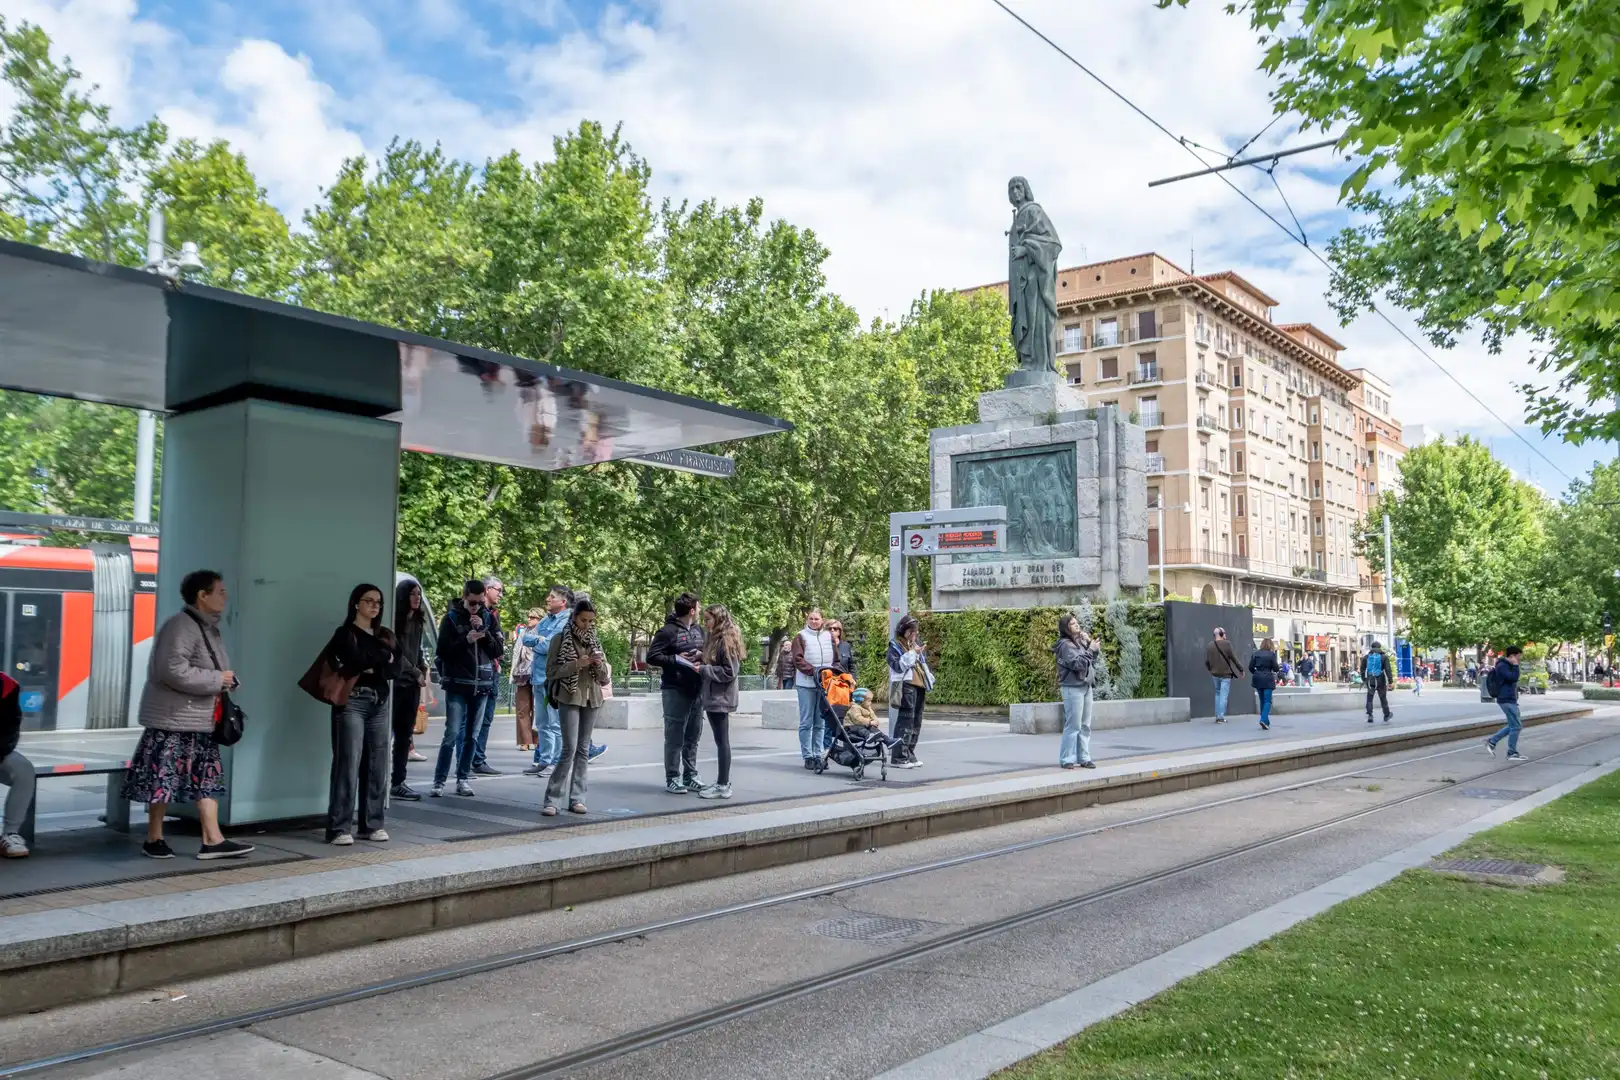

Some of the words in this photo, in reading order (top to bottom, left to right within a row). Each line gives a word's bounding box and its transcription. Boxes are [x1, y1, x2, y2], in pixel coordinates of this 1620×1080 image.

[679, 453, 732, 473] FRANCISCO
[51, 518, 86, 528] PLAZA
[91, 521, 104, 530] DE
[110, 522, 130, 531] SAN
[1000, 566, 1004, 574] A
[1012, 566, 1021, 574] SU
[1027, 564, 1044, 573] GRAN
[1010, 577, 1018, 585] EL
